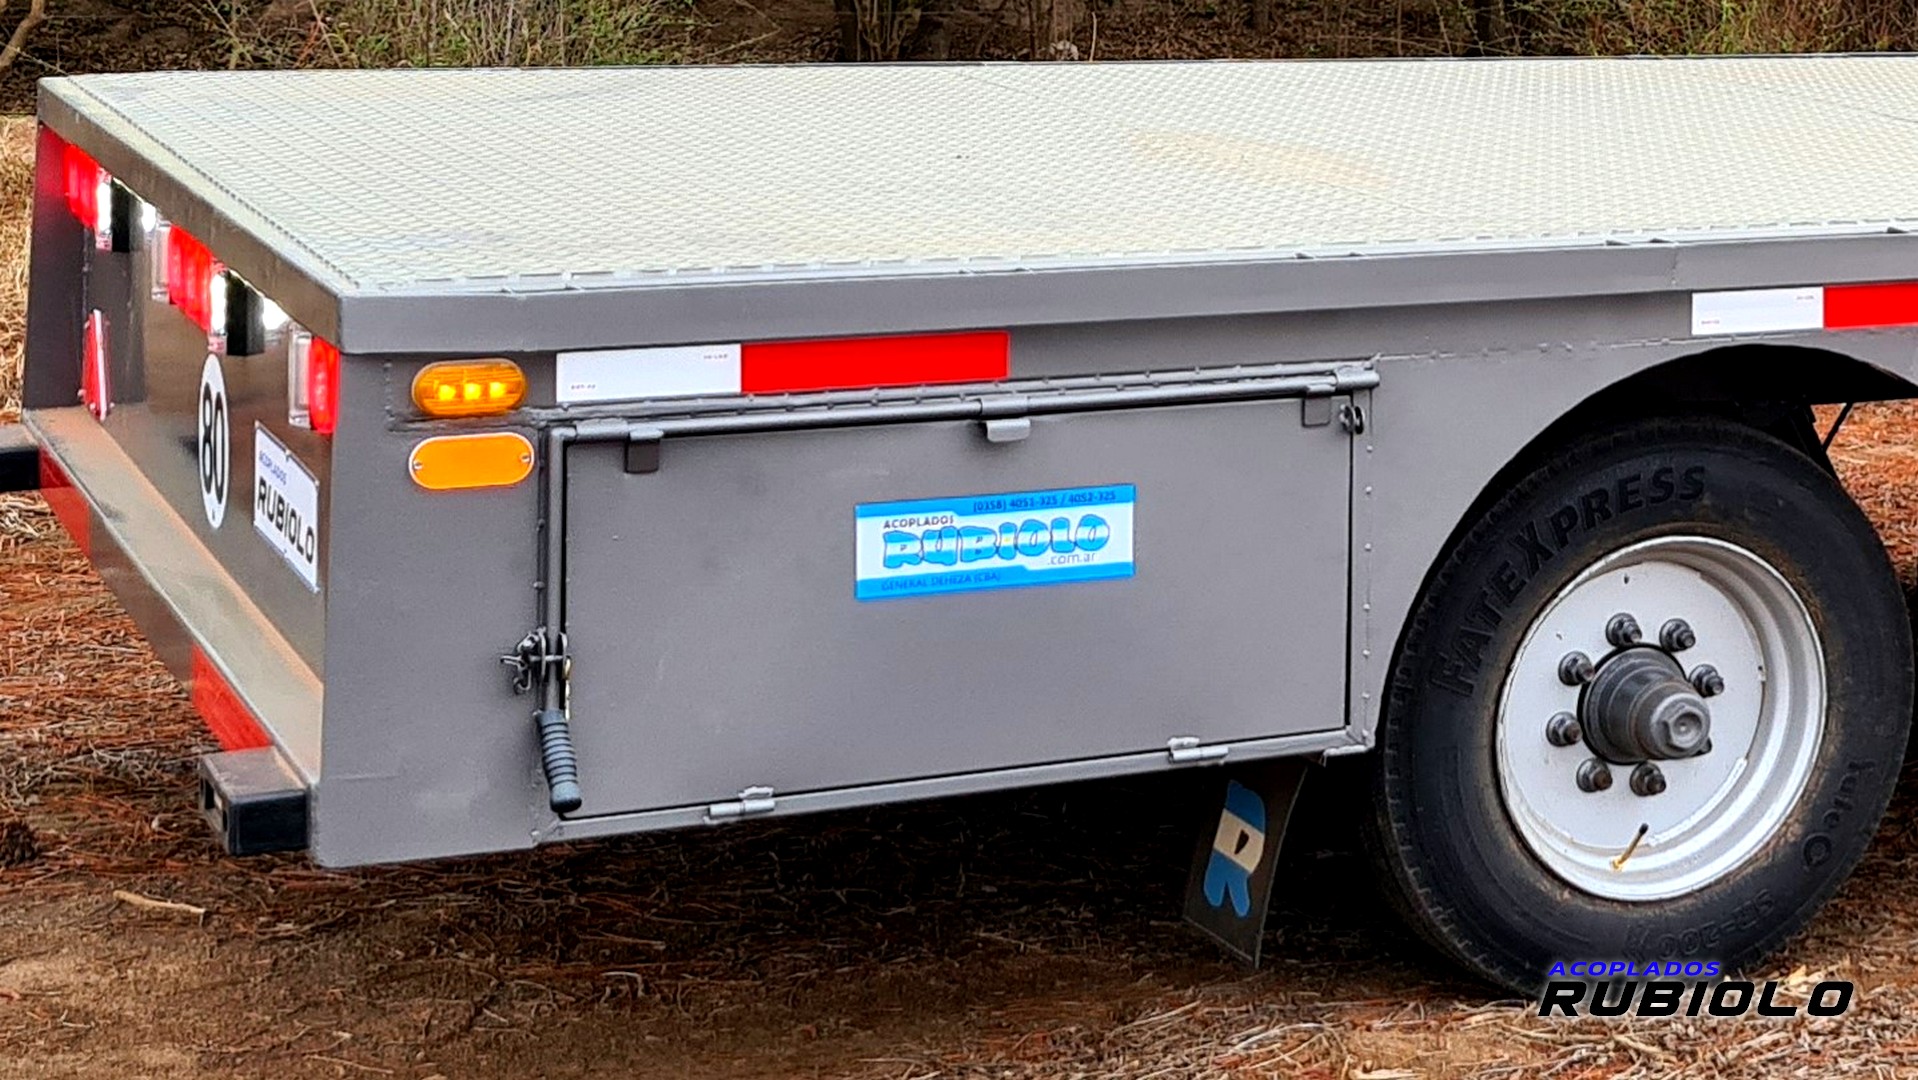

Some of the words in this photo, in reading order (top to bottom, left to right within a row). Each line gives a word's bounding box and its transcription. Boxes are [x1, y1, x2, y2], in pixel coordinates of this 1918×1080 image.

[202, 382, 225, 504] 80
[973, 501, 1007, 513] (0358)
[257, 476, 315, 564] RUBIOLO
[883, 515, 954, 530] ACOPLADOS
[883, 514, 1111, 569] RUBIOLO
[1047, 553, 1097, 566] .com.ar
[881, 578, 929, 592] GENERAL
[931, 574, 973, 589] DEHEZA
[974, 572, 1001, 586] (CBA)
